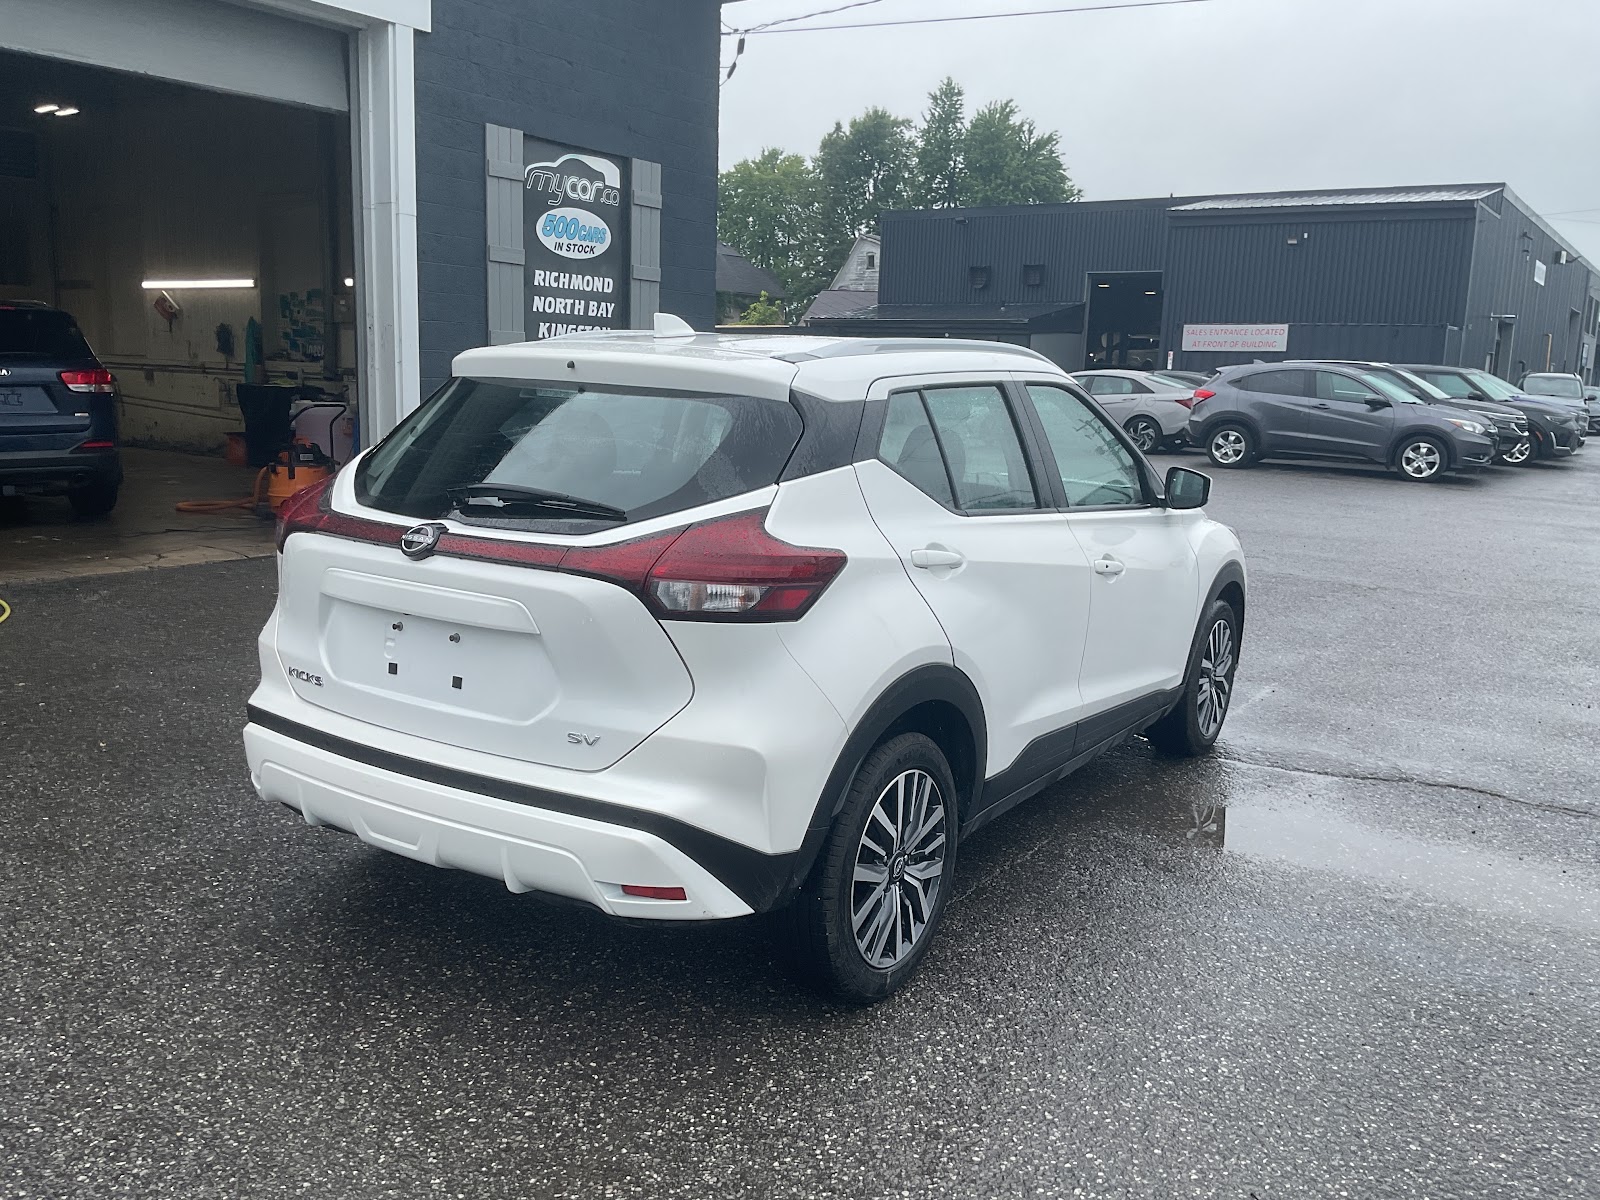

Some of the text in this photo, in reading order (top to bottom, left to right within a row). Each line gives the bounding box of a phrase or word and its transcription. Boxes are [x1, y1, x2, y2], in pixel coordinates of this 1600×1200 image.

[553, 241, 596, 254] IN STOCK
[534, 270, 613, 293] RICHMOND
[533, 296, 615, 317] NORTH BAY
[1186, 328, 1285, 336] SALES ENTRANCE LOCATED
[1192, 340, 1277, 348] AT FRONT OF BUILDING
[401, 534, 435, 544] NISSAN
[288, 666, 323, 687] KICKS
[567, 731, 601, 746] SV
